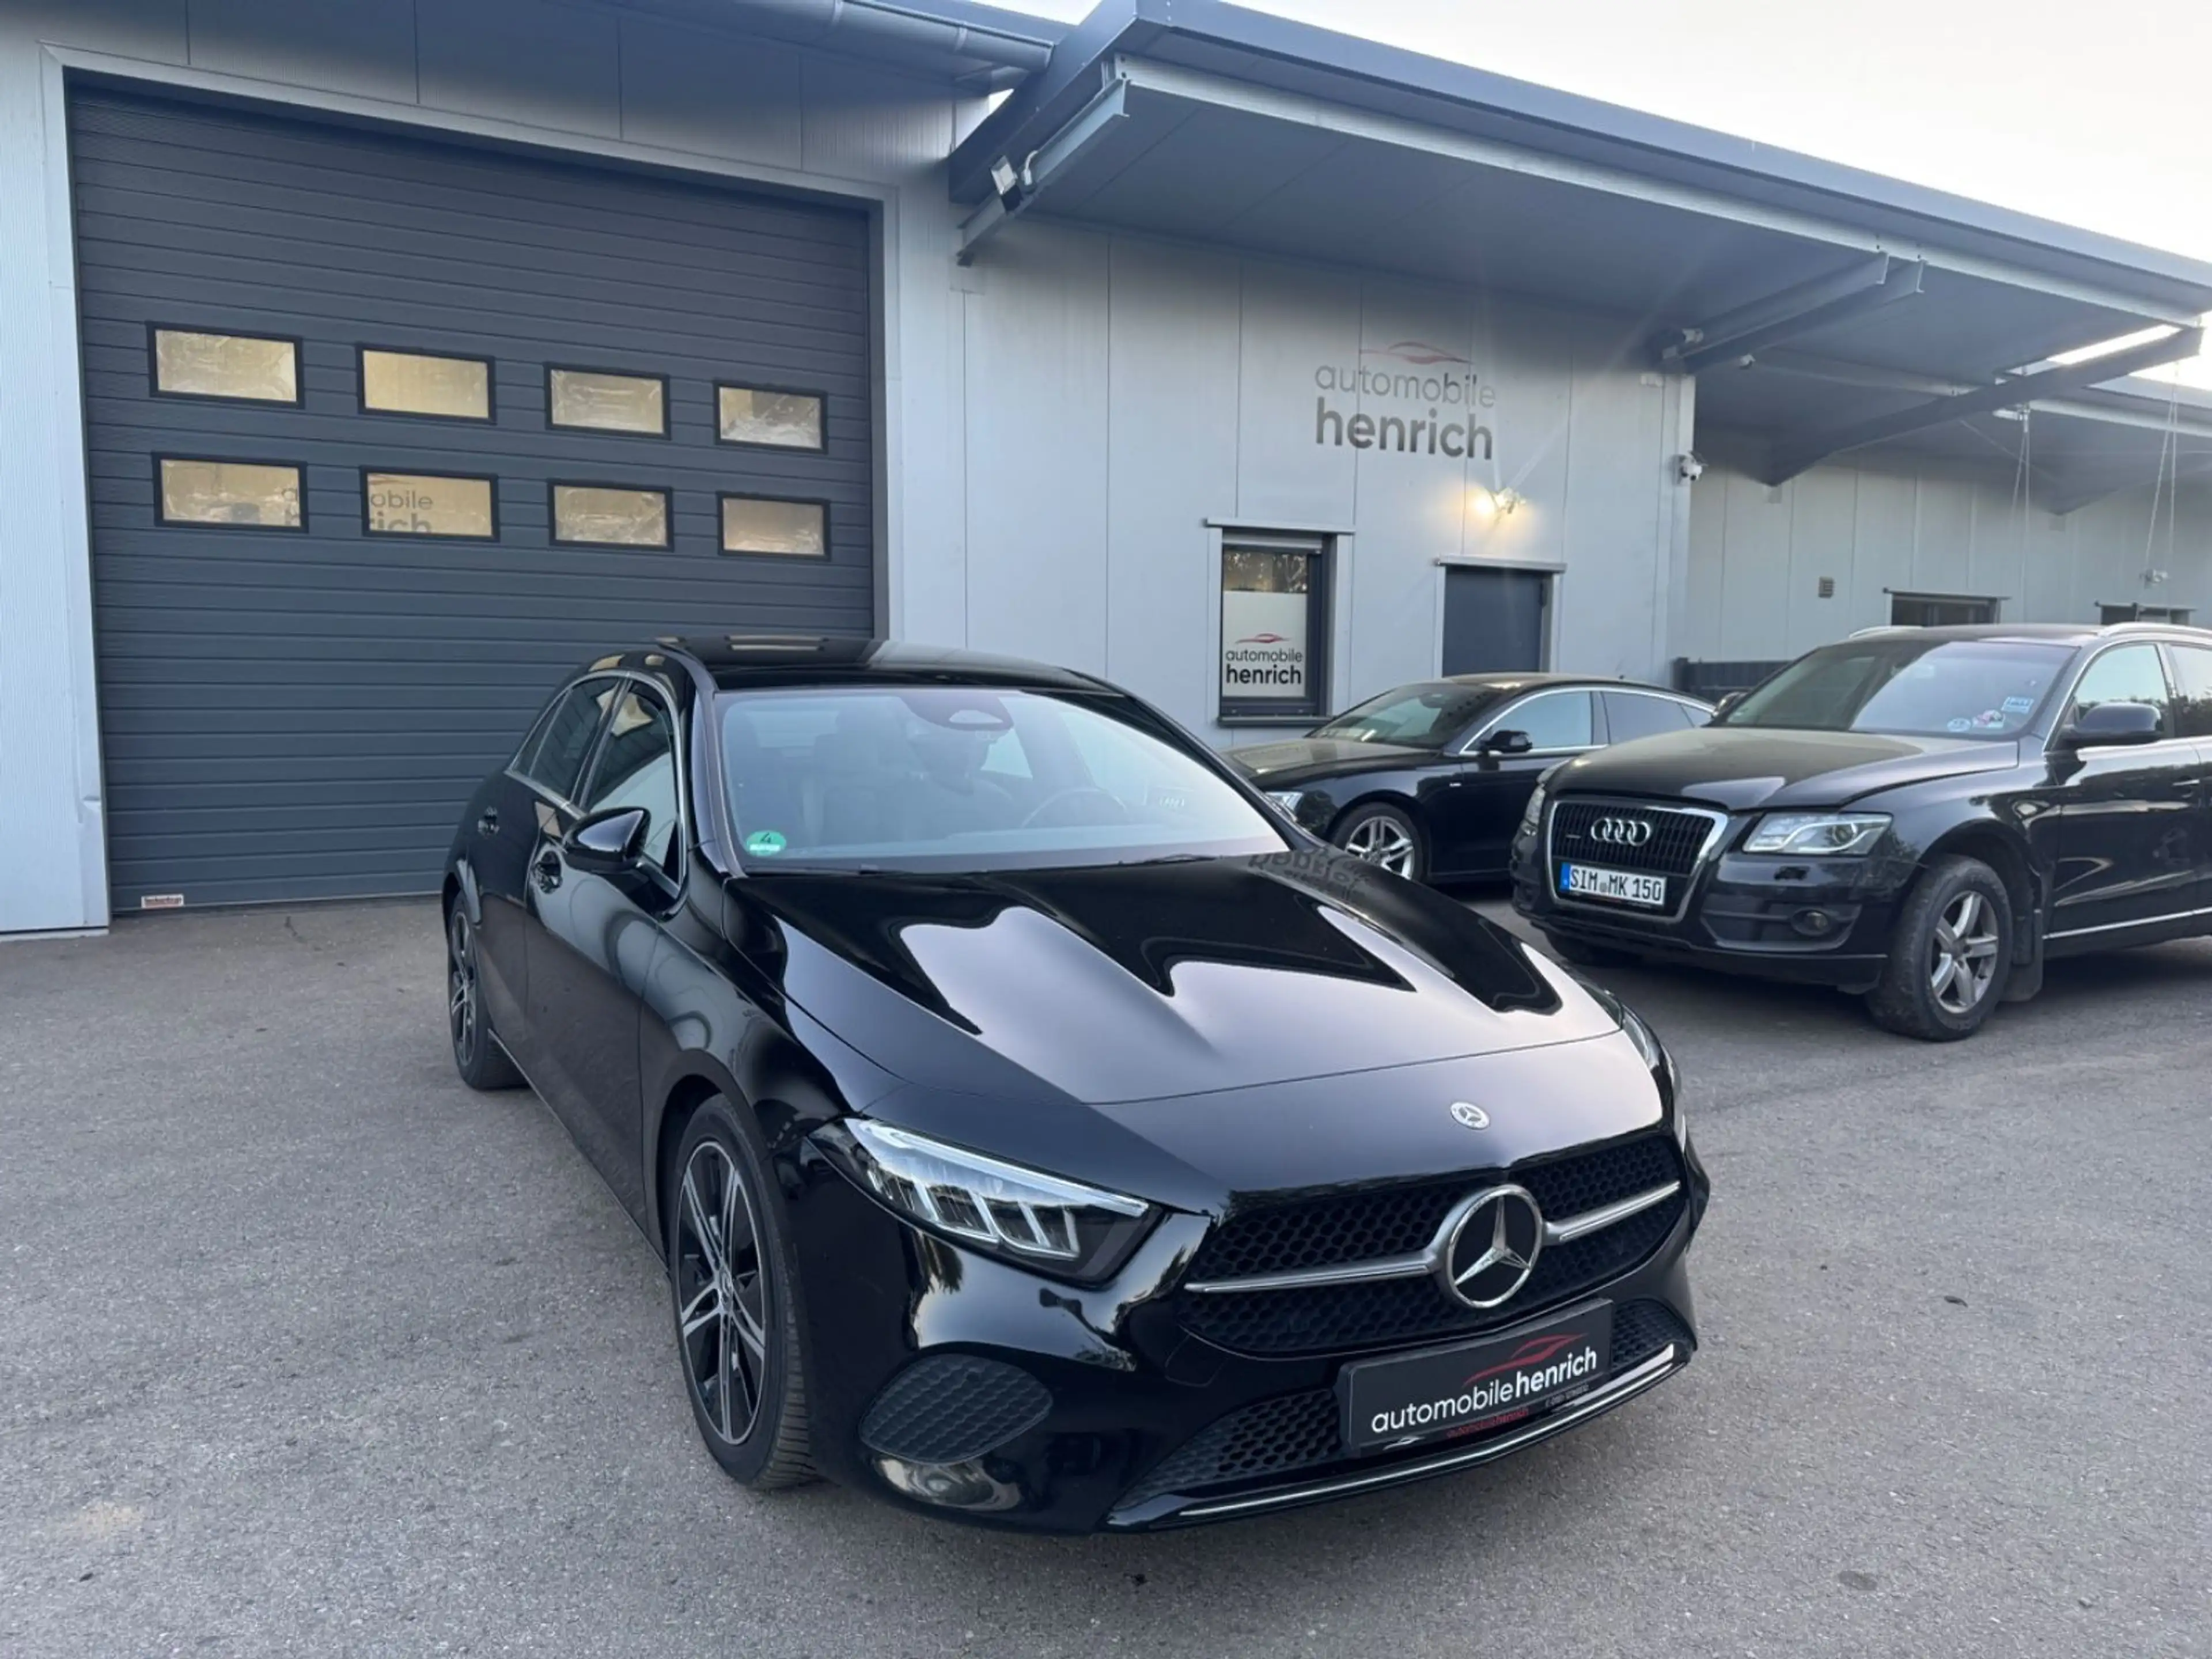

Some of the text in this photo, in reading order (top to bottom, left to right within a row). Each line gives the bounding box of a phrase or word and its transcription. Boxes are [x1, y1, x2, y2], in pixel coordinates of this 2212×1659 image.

[1315, 365, 1496, 408] automobile
[1316, 397, 1493, 460] henrich
[1225, 649, 1303, 662] automobile
[1226, 664, 1302, 684] henrich
[1570, 868, 1598, 891] SIM
[1608, 874, 1628, 896] MK
[1631, 877, 1662, 902] 150
